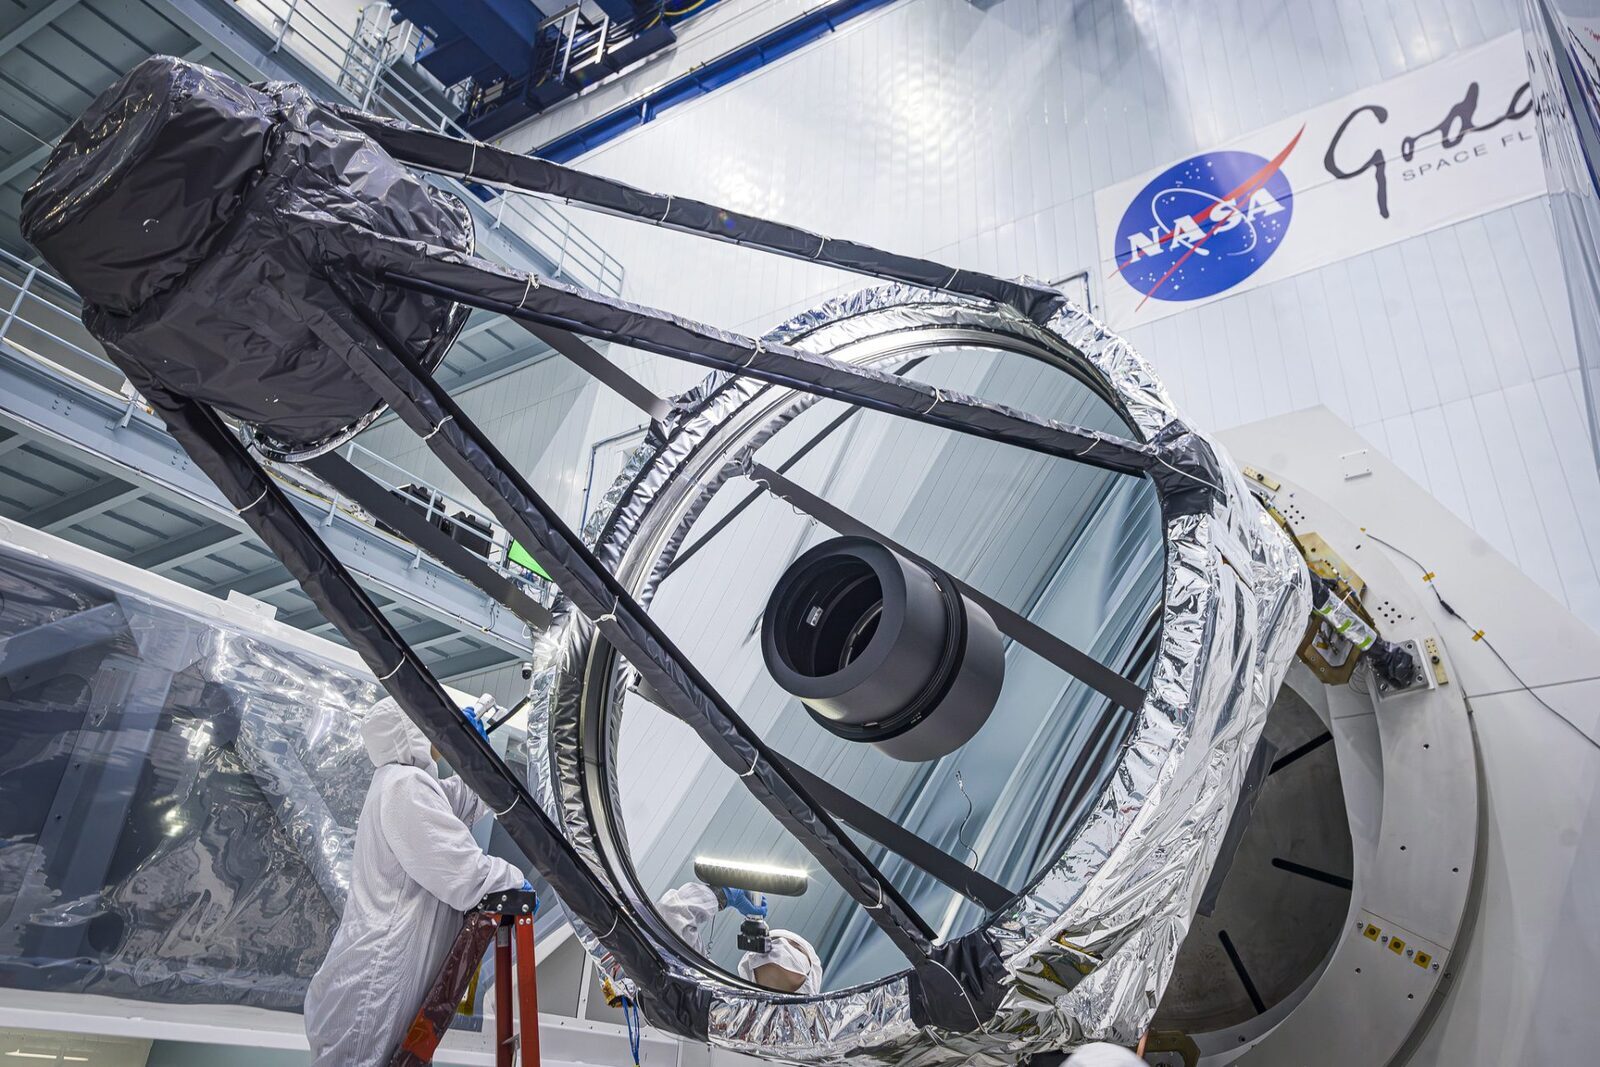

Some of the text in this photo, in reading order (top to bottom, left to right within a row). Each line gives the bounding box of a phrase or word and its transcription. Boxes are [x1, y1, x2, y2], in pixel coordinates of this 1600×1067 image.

[1402, 130, 1534, 182] SPACE FL
[1127, 187, 1286, 264] NASA
